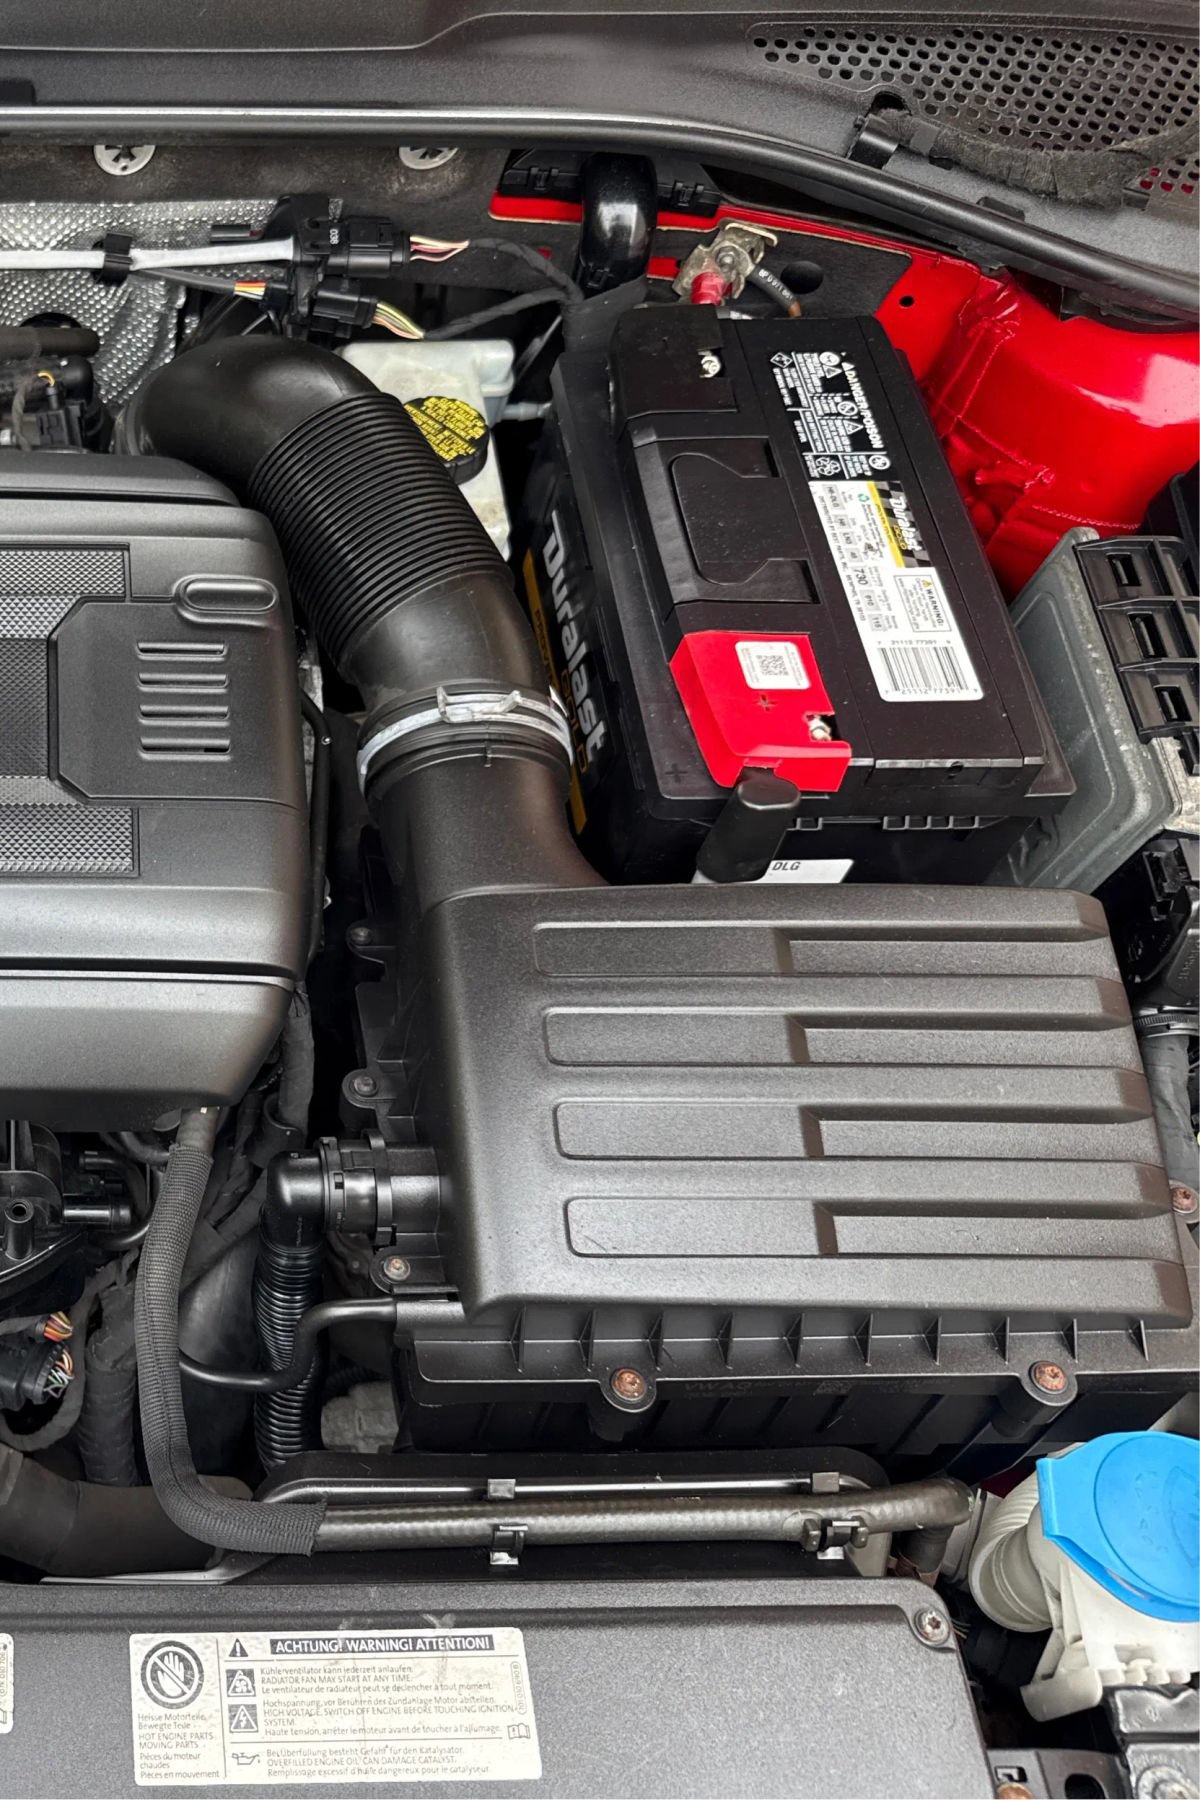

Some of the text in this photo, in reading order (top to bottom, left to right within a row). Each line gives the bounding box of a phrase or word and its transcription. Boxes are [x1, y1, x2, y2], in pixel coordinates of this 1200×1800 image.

[845, 371, 884, 448] DANGER/POISON
[887, 496, 924, 550] Duralast
[853, 568, 868, 585] 730
[543, 509, 606, 764] Duralast
[772, 861, 801, 871] DLG
[276, 1636, 490, 1653] ACHTUNG! WARNING! ATTENTION!
[323, 1666, 342, 1674] kann
[344, 1666, 376, 1676] jederzeit
[261, 1676, 300, 1684] RADIATOR
[301, 1676, 317, 1684] FAN
[318, 1676, 338, 1684] MAY
[339, 1676, 360, 1684] START
[373, 1674, 390, 1682] ANY
[262, 1686, 270, 1694] Le
[271, 1686, 314, 1694] ventilateur
[315, 1685, 325, 1693] de
[362, 1684, 380, 1692] peut
[440, 1682, 457, 1690] tout
[434, 1696, 458, 1704] Motor
[324, 1706, 354, 1715] SWITCH
[356, 1706, 370, 1714] OFF
[372, 1706, 401, 1714] ENGINE
[404, 1706, 433, 1714] BEFORE
[434, 1705, 476, 1714] TOUCHING
[478, 1704, 514, 1713] IGNITION
[138, 1713, 162, 1722] Heisse
[138, 1722, 191, 1730] Bewegte Teile
[266, 1728, 289, 1736] Haute
[358, 1726, 386, 1735] moteur
[388, 1726, 410, 1734] avant
[412, 1726, 421, 1734] de
[422, 1726, 452, 1734] toucher
[138, 1732, 156, 1740] HOT
[158, 1732, 190, 1740] ENGINE
[139, 1741, 199, 1750] MOVING PARTS
[162, 1752, 172, 1761] du
[174, 1752, 200, 1760] moteur
[329, 1748, 359, 1757] besteht
[360, 1746, 386, 1756] Gefahr
[404, 1746, 418, 1754] den
[140, 1762, 170, 1770] chaudes
[267, 1758, 314, 1767] OVERFILLED
[314, 1758, 345, 1766] ENGINE
[346, 1758, 358, 1766] OIL
[362, 1756, 380, 1764] CAN
[381, 1756, 416, 1764] DAMAGE
[175, 1770, 220, 1778] mouvement
[268, 1768, 316, 1778] Remplissage
[318, 1768, 350, 1776] excessif
[378, 1766, 419, 1776] dangereux
[421, 1766, 440, 1775] pour
[441, 1765, 449, 1774] le
